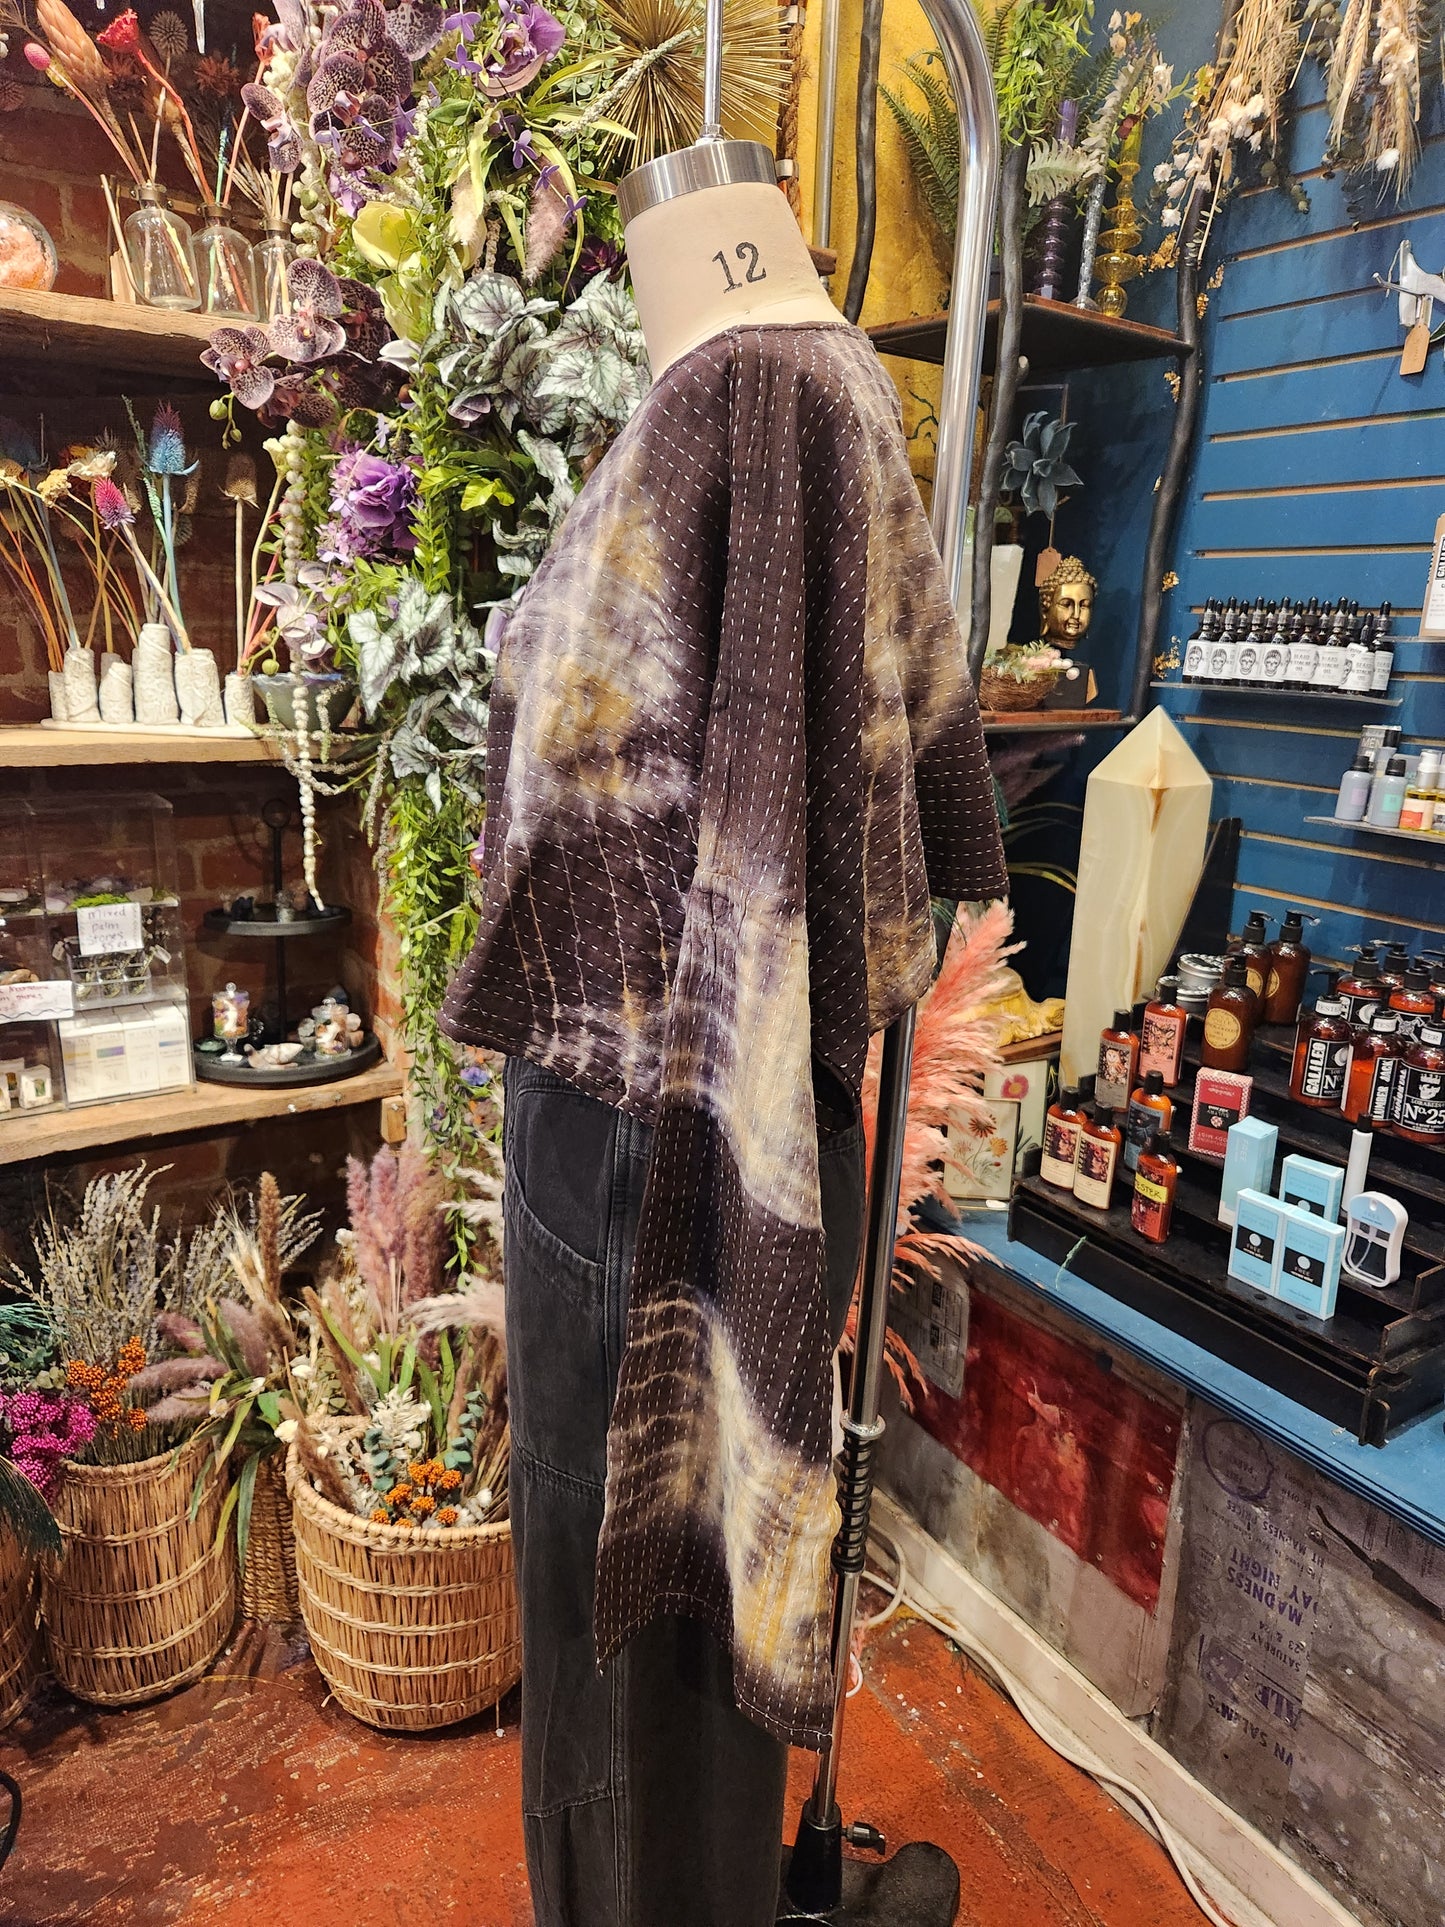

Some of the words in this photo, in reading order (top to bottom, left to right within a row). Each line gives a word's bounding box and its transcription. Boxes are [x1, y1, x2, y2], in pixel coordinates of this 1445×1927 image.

[712, 241, 767, 293] 12
[1305, 1042, 1326, 1094] GALILEO
[1379, 1060, 1394, 1083] JACK
[1373, 1086, 1389, 1119] LUMBER
[1136, 1182, 1162, 1200] ESTER
[1230, 1547, 1280, 1590] NIGHT
[1227, 1566, 1302, 1627] MADNESS
[1251, 1631, 1301, 1672] SATURDAY
